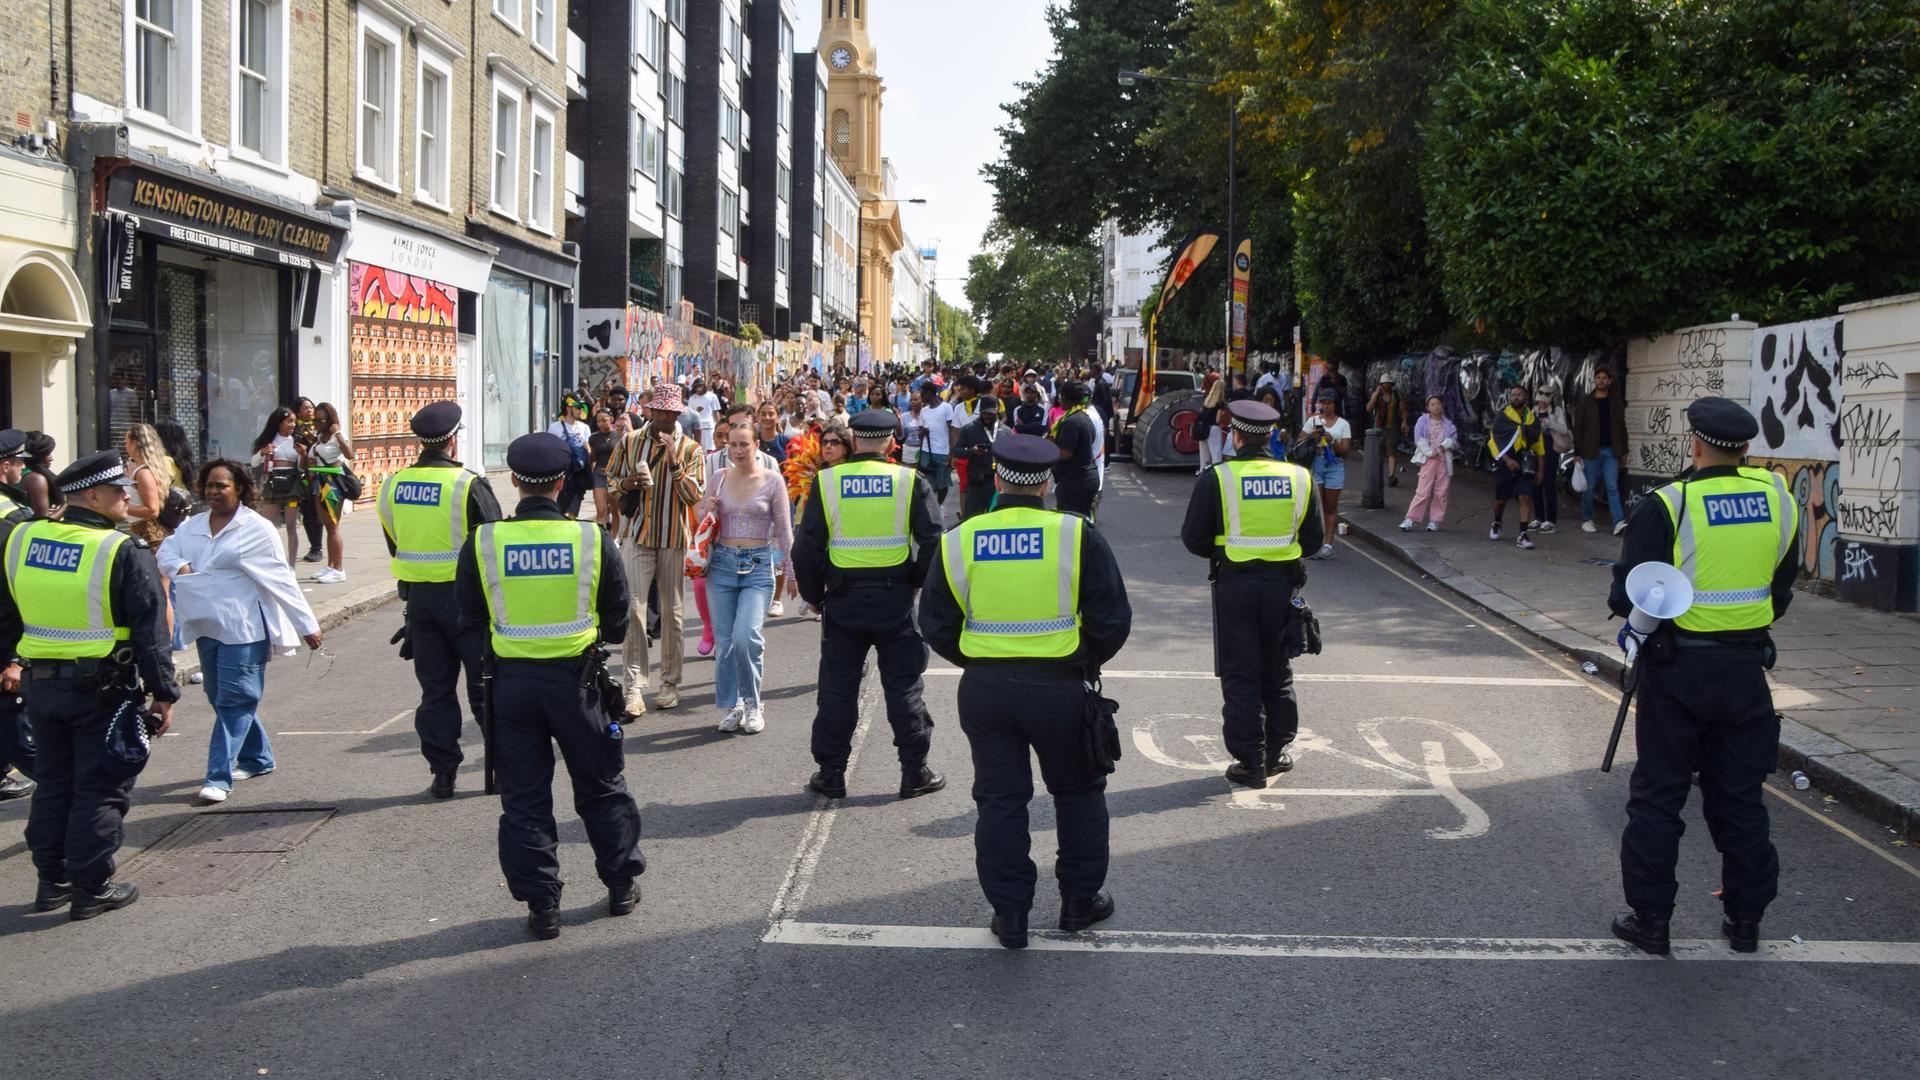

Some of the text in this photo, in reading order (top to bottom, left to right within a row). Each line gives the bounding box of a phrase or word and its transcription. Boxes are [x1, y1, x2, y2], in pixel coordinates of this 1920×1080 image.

[135, 180, 331, 253] KENSINGTON PARK DRY CLEANER
[170, 226, 255, 257] FREE COLLECTION AND DELIVERY
[416, 243, 436, 257] JOYCE
[279, 252, 289, 264] 020
[391, 249, 433, 271] LONDON
[121, 267, 133, 290] DRY
[396, 484, 440, 502] POLICE
[843, 478, 890, 495] POLICE
[1244, 477, 1290, 496] POLICE
[1708, 497, 1769, 520] POLICE
[27, 542, 80, 568] POLICE
[976, 533, 1040, 555] POLICE
[507, 548, 571, 571] POLICE
